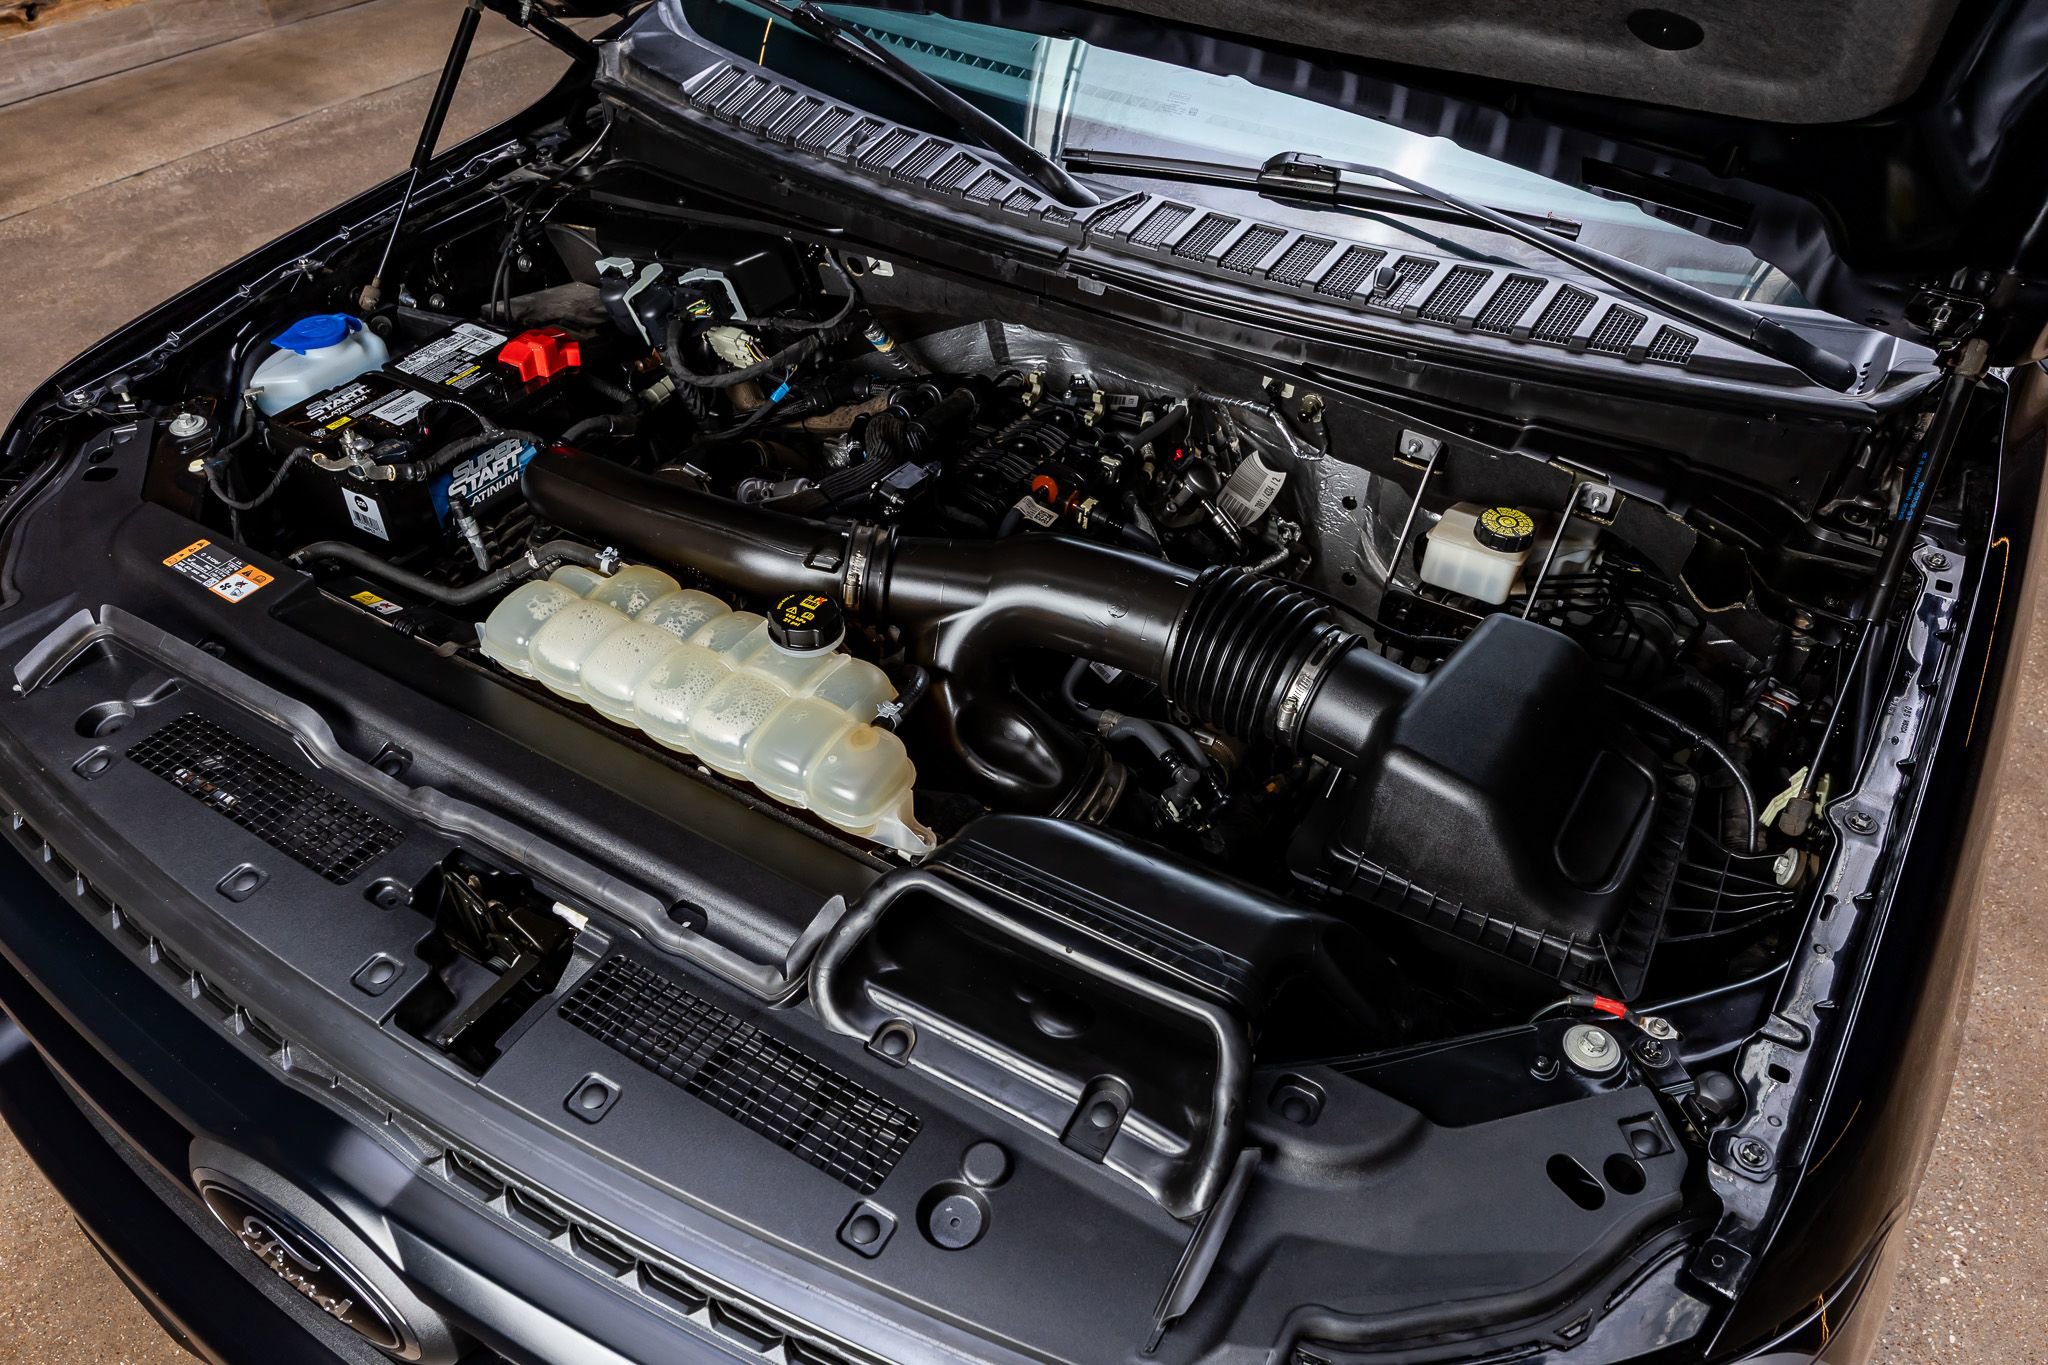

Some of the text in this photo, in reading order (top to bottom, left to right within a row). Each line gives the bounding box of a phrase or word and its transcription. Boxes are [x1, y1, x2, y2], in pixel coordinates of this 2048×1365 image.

[306, 382, 363, 410] SUPER
[306, 385, 368, 419] START
[318, 395, 368, 422] PLATINUM
[448, 447, 523, 497] START
[453, 439, 521, 481] SUPER
[470, 471, 519, 507] ATINUM
[236, 1216, 353, 1325] Ford
